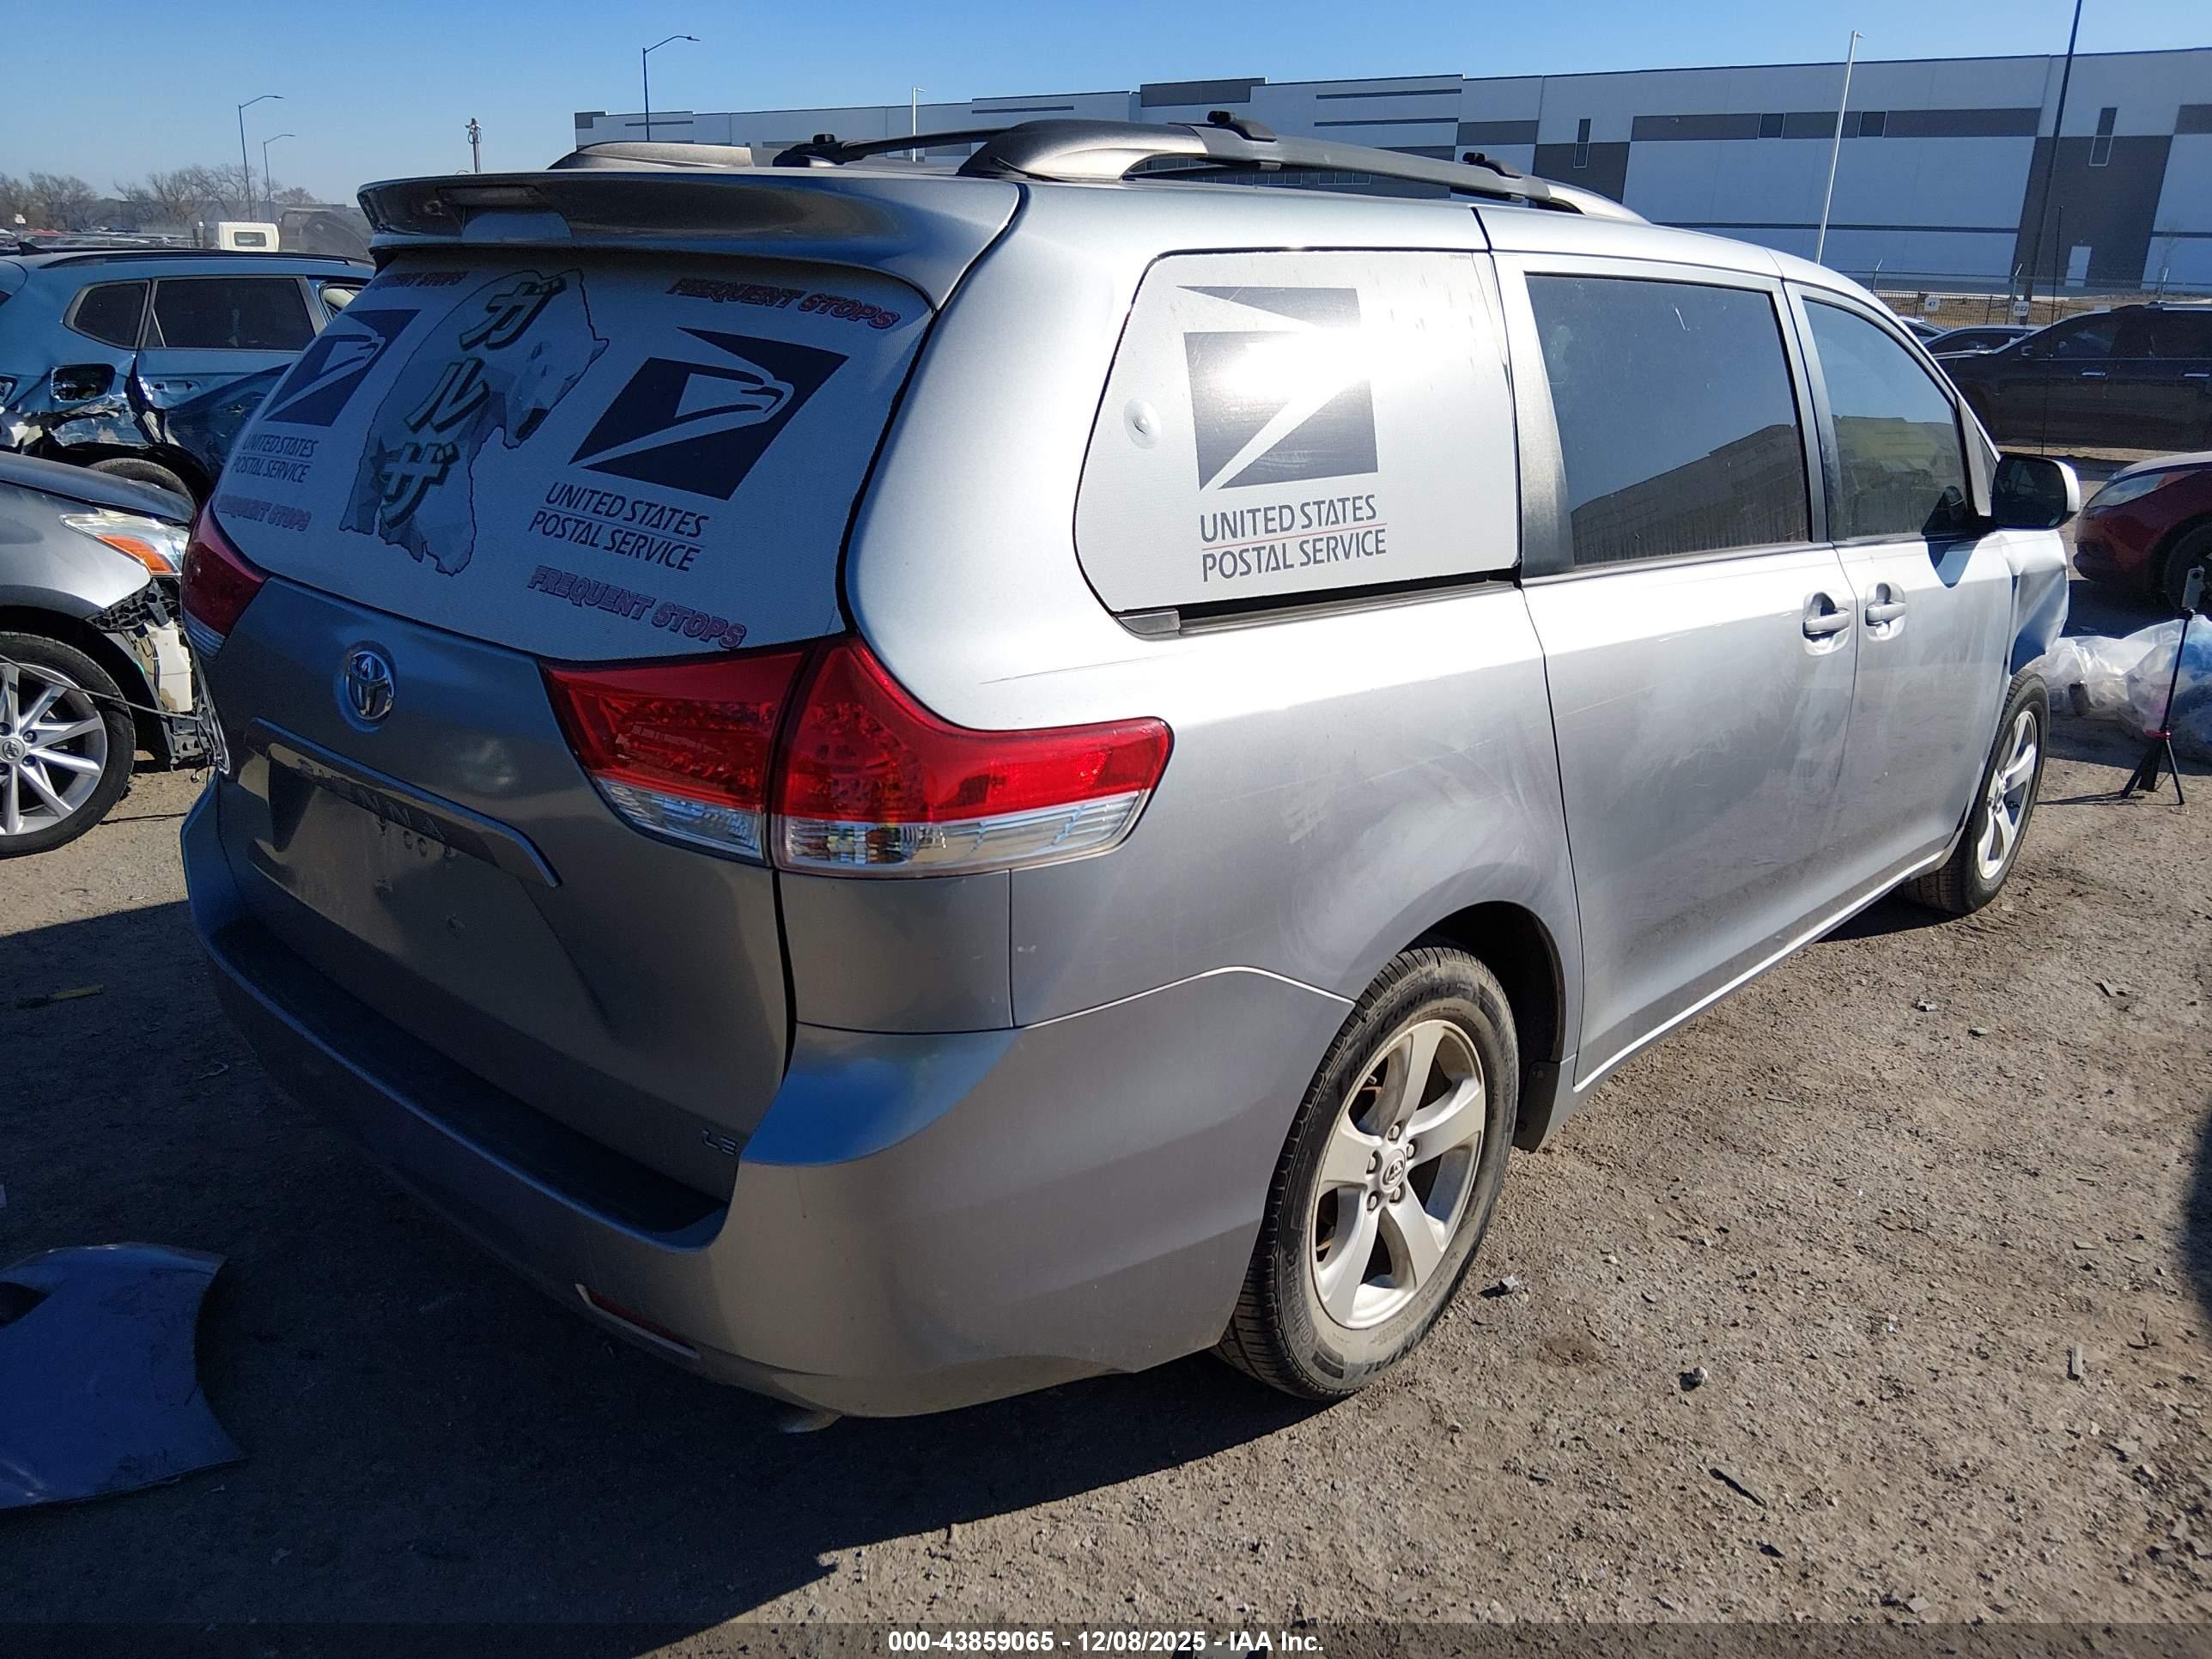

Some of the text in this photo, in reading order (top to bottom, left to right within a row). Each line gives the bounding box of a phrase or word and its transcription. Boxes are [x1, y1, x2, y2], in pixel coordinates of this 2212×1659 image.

[666, 277, 901, 330] FREQUENT STOPS
[380, 275, 567, 530] ガルザ
[242, 434, 319, 458] UNITED STATES
[262, 459, 311, 483] SERVICE
[545, 482, 709, 538] UNITED STATES
[1200, 494, 1377, 544] UNITED STATES
[528, 510, 702, 572] POSTAL SERVICE
[1202, 529, 1388, 583] POSTAL SERVICE
[527, 565, 747, 650] FREQUENT STOPS
[701, 1128, 738, 1156] LE
